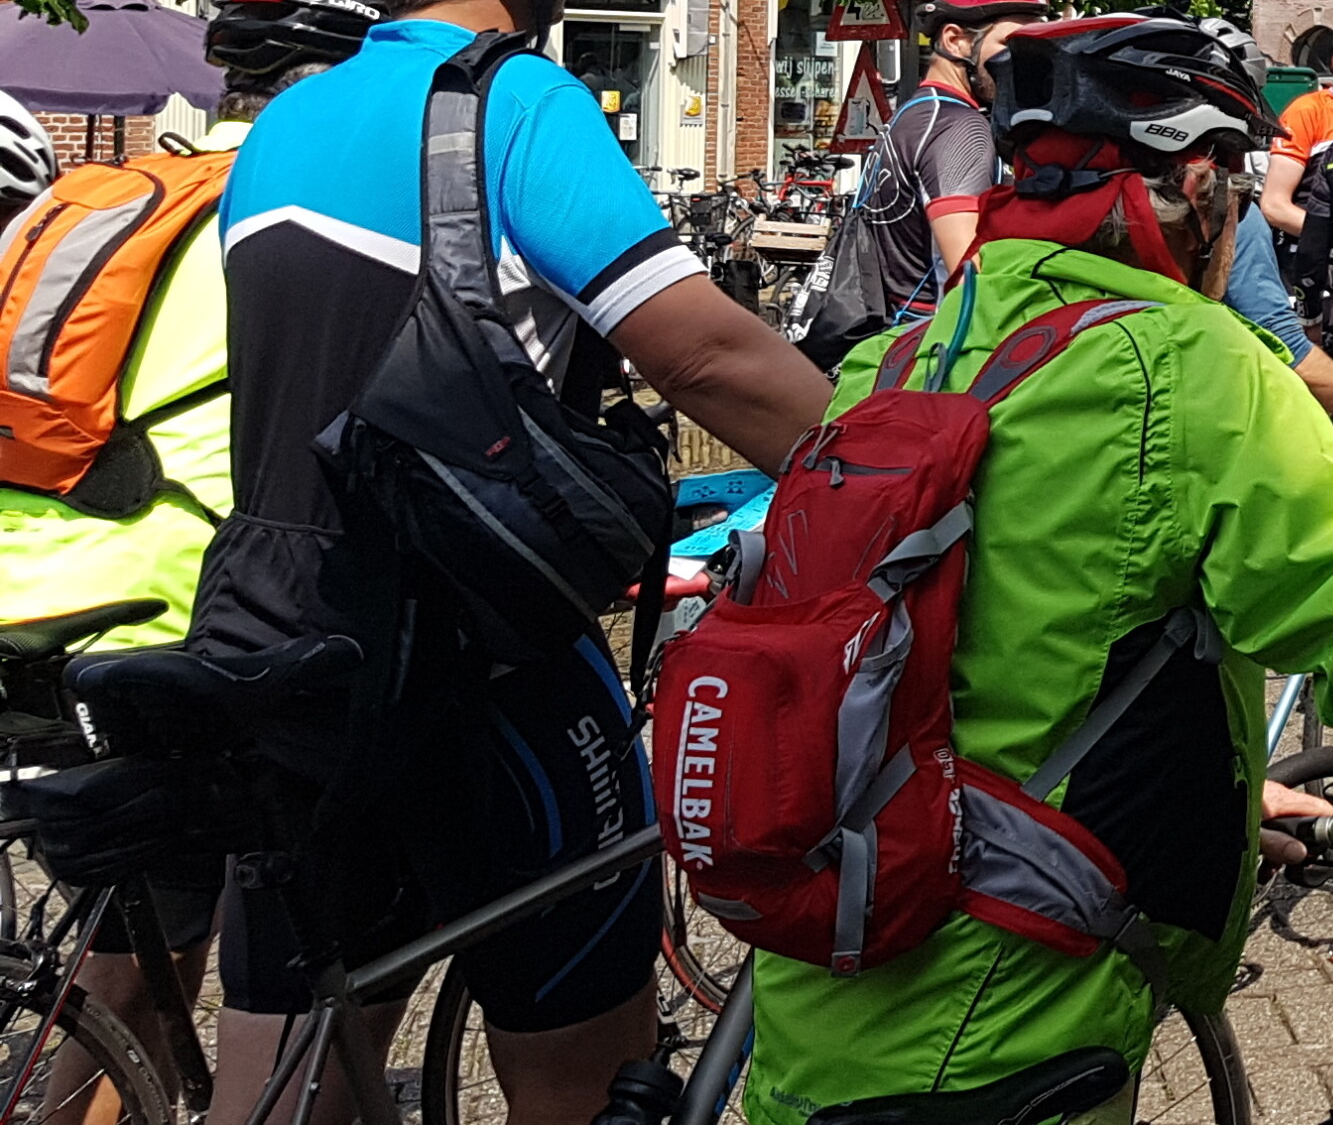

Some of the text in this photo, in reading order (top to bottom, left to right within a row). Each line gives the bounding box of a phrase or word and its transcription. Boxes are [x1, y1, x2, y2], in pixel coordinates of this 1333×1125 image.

[1165, 67, 1191, 83] JAYA
[1144, 123, 1190, 143] BBB
[680, 675, 729, 867] CAMELBAK
